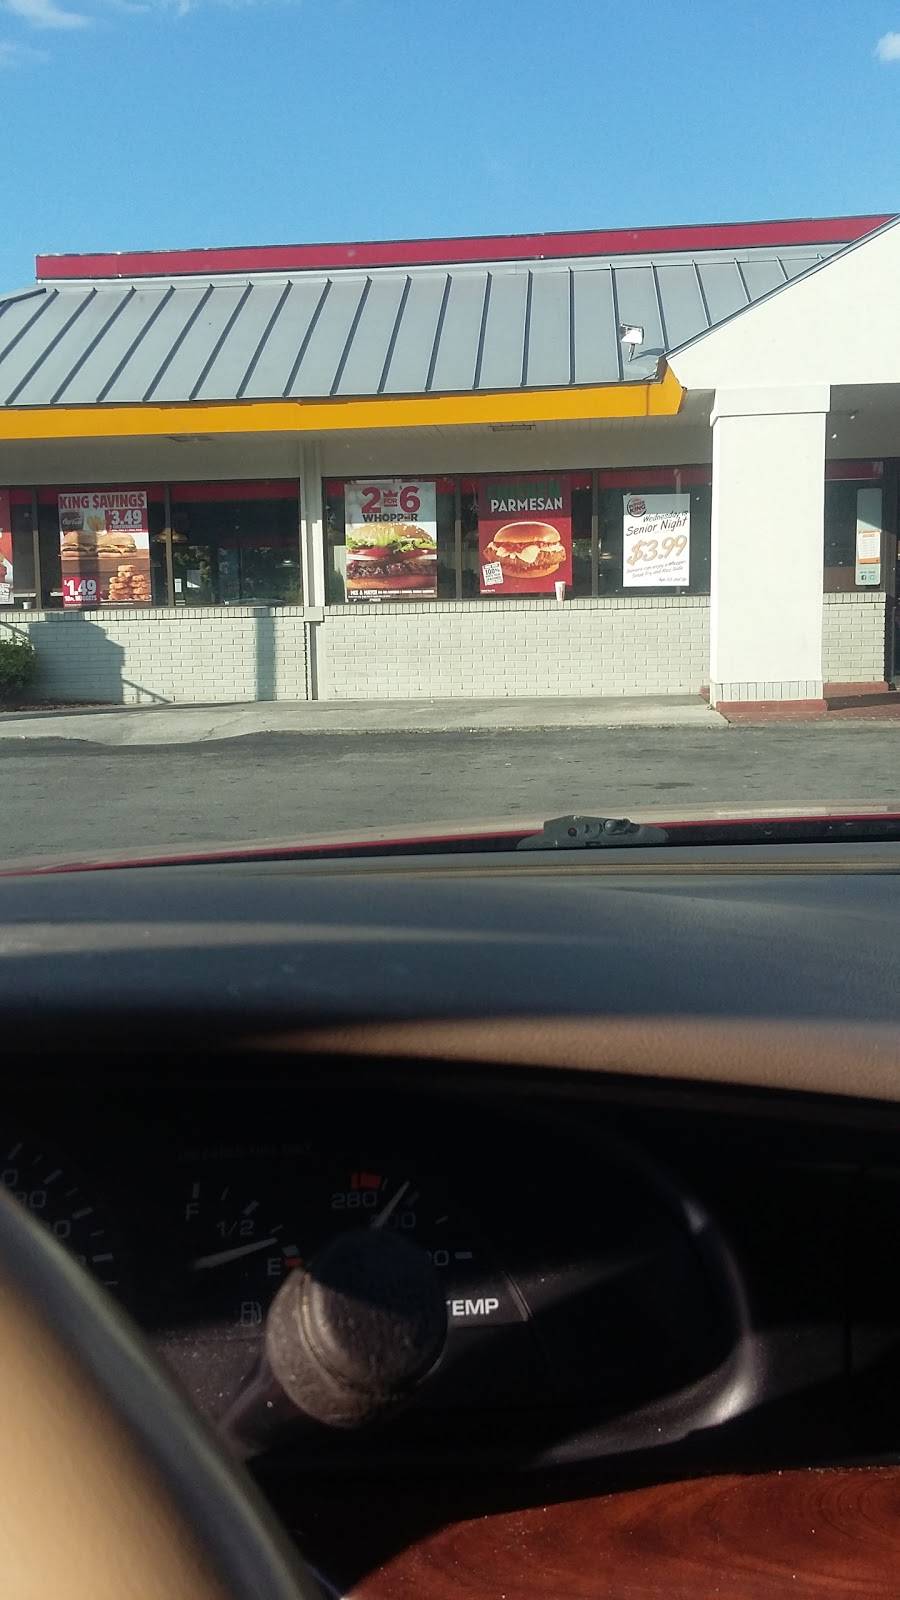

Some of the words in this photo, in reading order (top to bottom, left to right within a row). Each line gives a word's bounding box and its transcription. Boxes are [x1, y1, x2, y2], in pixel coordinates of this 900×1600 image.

[58, 495, 90, 509] KING
[361, 486, 382, 513] 2
[490, 497, 563, 513] PARMESAN
[626, 523, 658, 537] Senior
[660, 516, 688, 532] Night
[626, 534, 688, 567] $3.99
[331, 1192, 377, 1209] 280
[184, 1202, 200, 1221] F
[217, 1219, 254, 1237] 1/2
[267, 1258, 281, 1276] E
[446, 1297, 499, 1316] EMP
